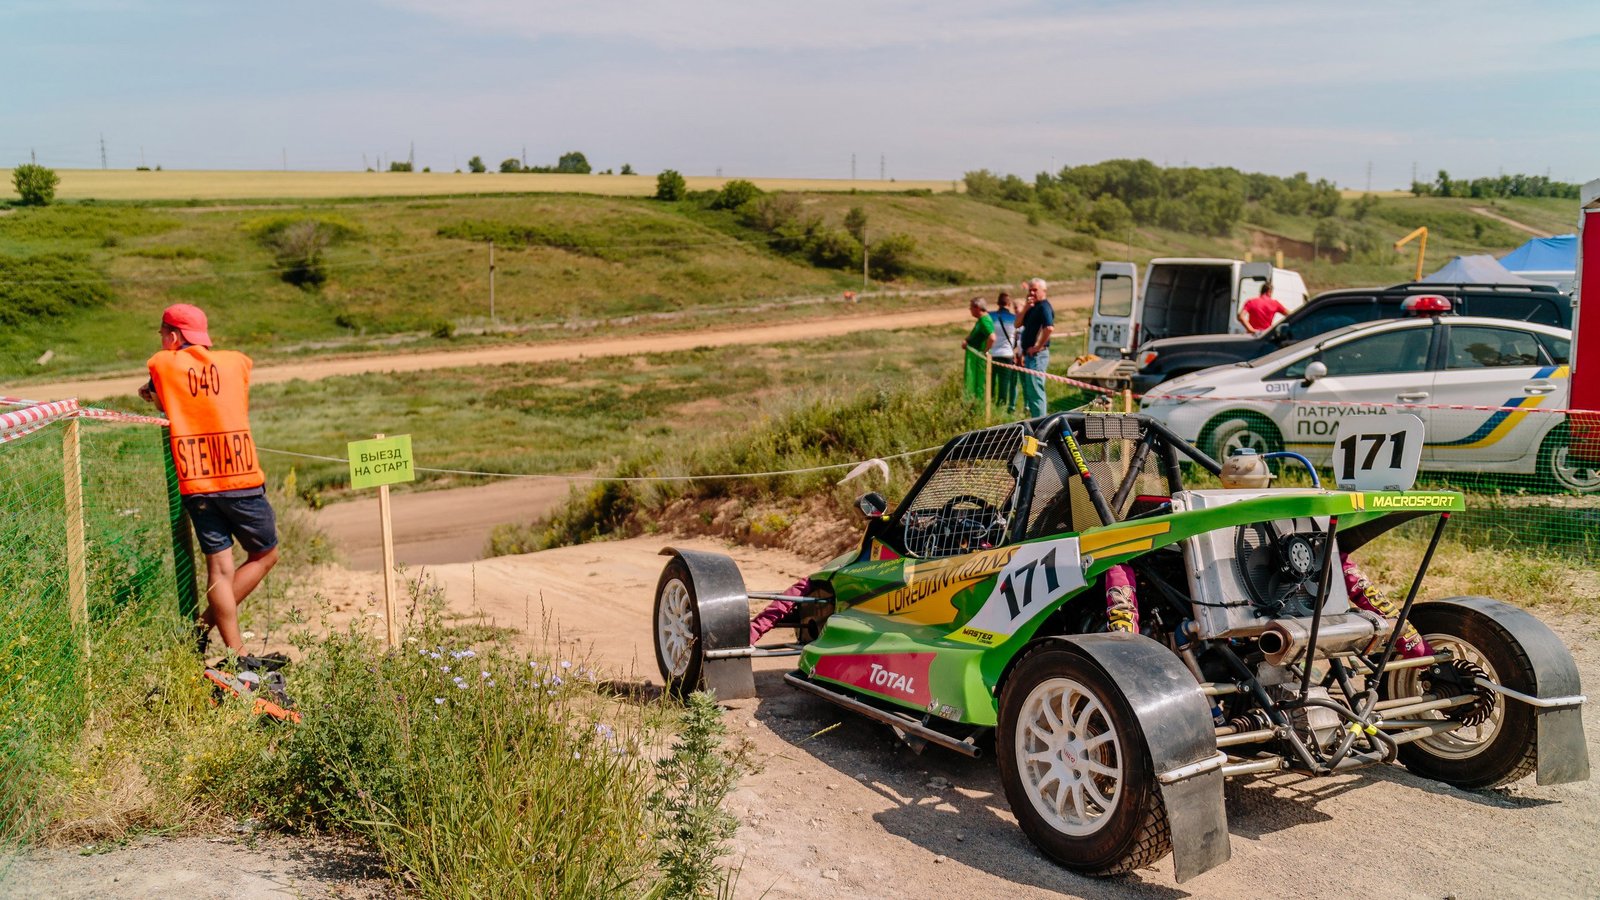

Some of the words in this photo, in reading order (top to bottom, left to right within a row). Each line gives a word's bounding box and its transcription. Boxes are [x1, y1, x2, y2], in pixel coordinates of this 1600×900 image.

[188, 364, 219, 397] 040
[1265, 383, 1289, 392] 0311
[177, 433, 253, 478] STEWARD
[360, 448, 402, 463] ВЫЕЗД
[1064, 435, 1089, 473] MOLDOVA
[1340, 430, 1406, 480] 171
[354, 465, 371, 477] НА
[373, 460, 409, 474] СТАРТ
[1373, 496, 1455, 507] MACROSPORT
[999, 546, 1061, 622] 171
[962, 628, 994, 641] MASTER
